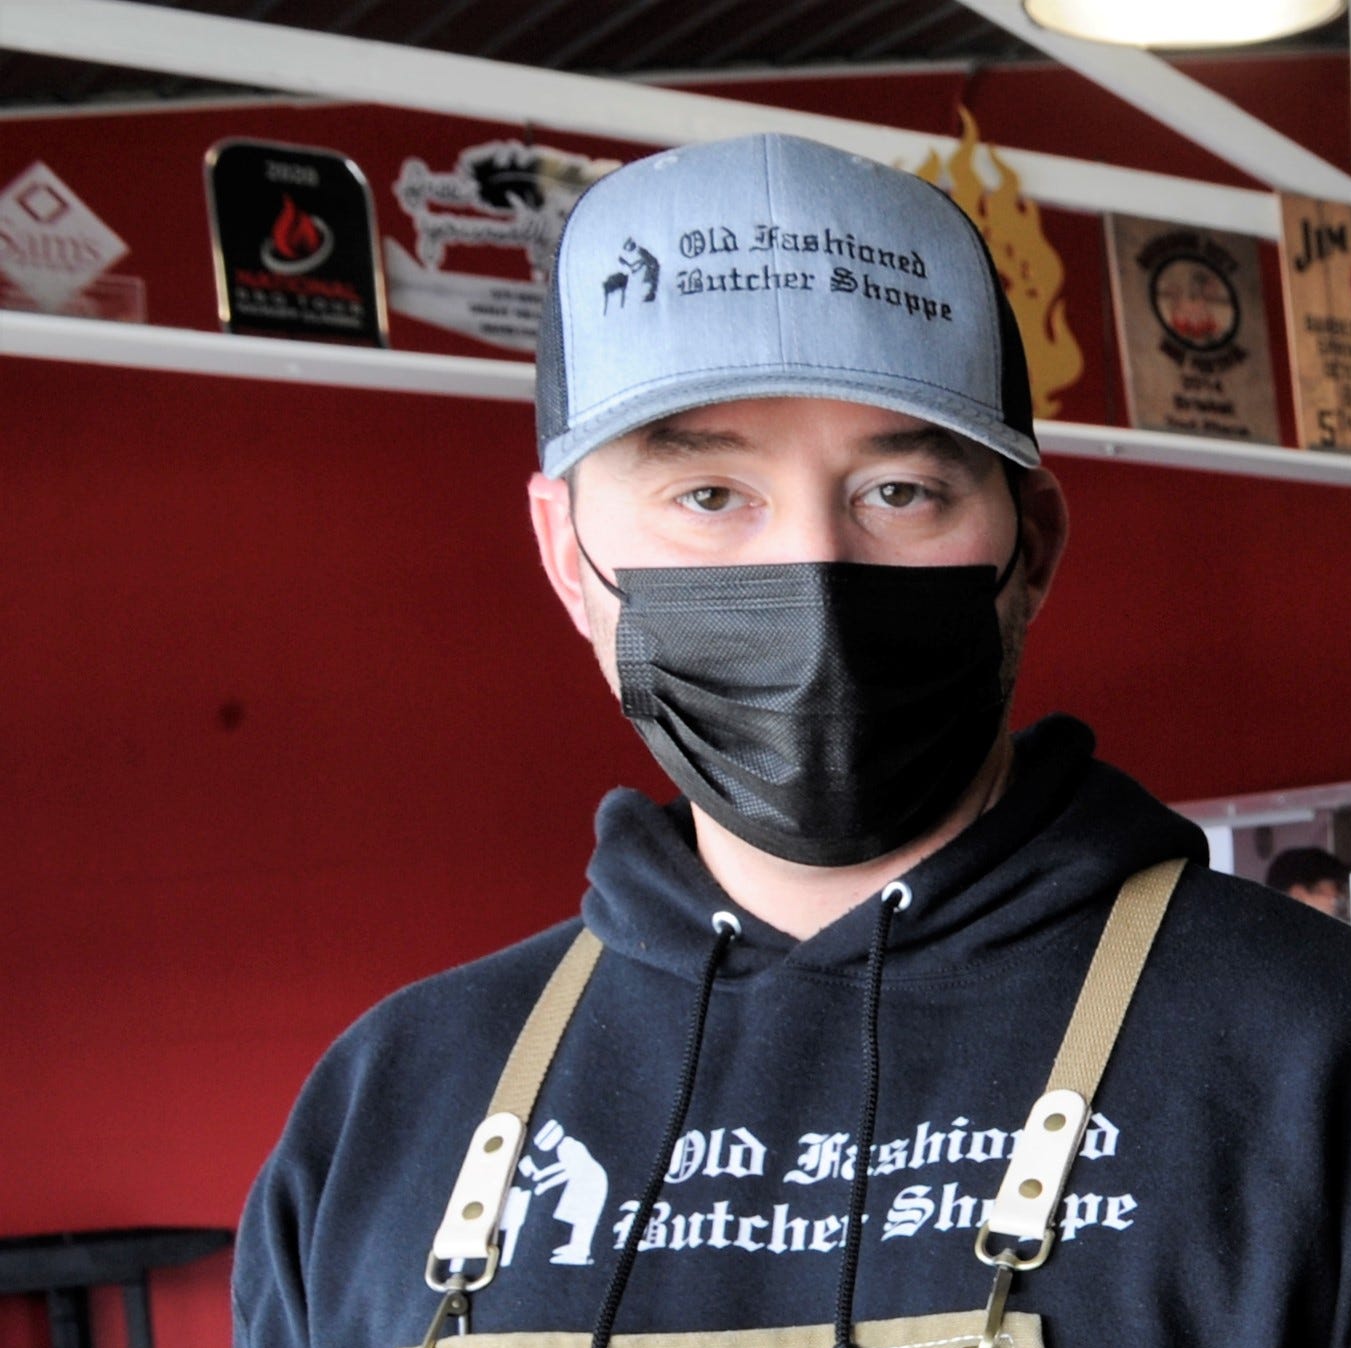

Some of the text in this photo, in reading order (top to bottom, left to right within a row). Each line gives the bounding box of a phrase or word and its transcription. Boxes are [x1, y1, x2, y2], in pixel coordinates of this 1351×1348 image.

[680, 225, 927, 279] Old Fashioned
[1295, 216, 1347, 272] JIM
[677, 265, 952, 321] Butcher Shoppe
[663, 1112, 1120, 1185] Old Fashiod
[881, 1181, 1138, 1243] Shpe
